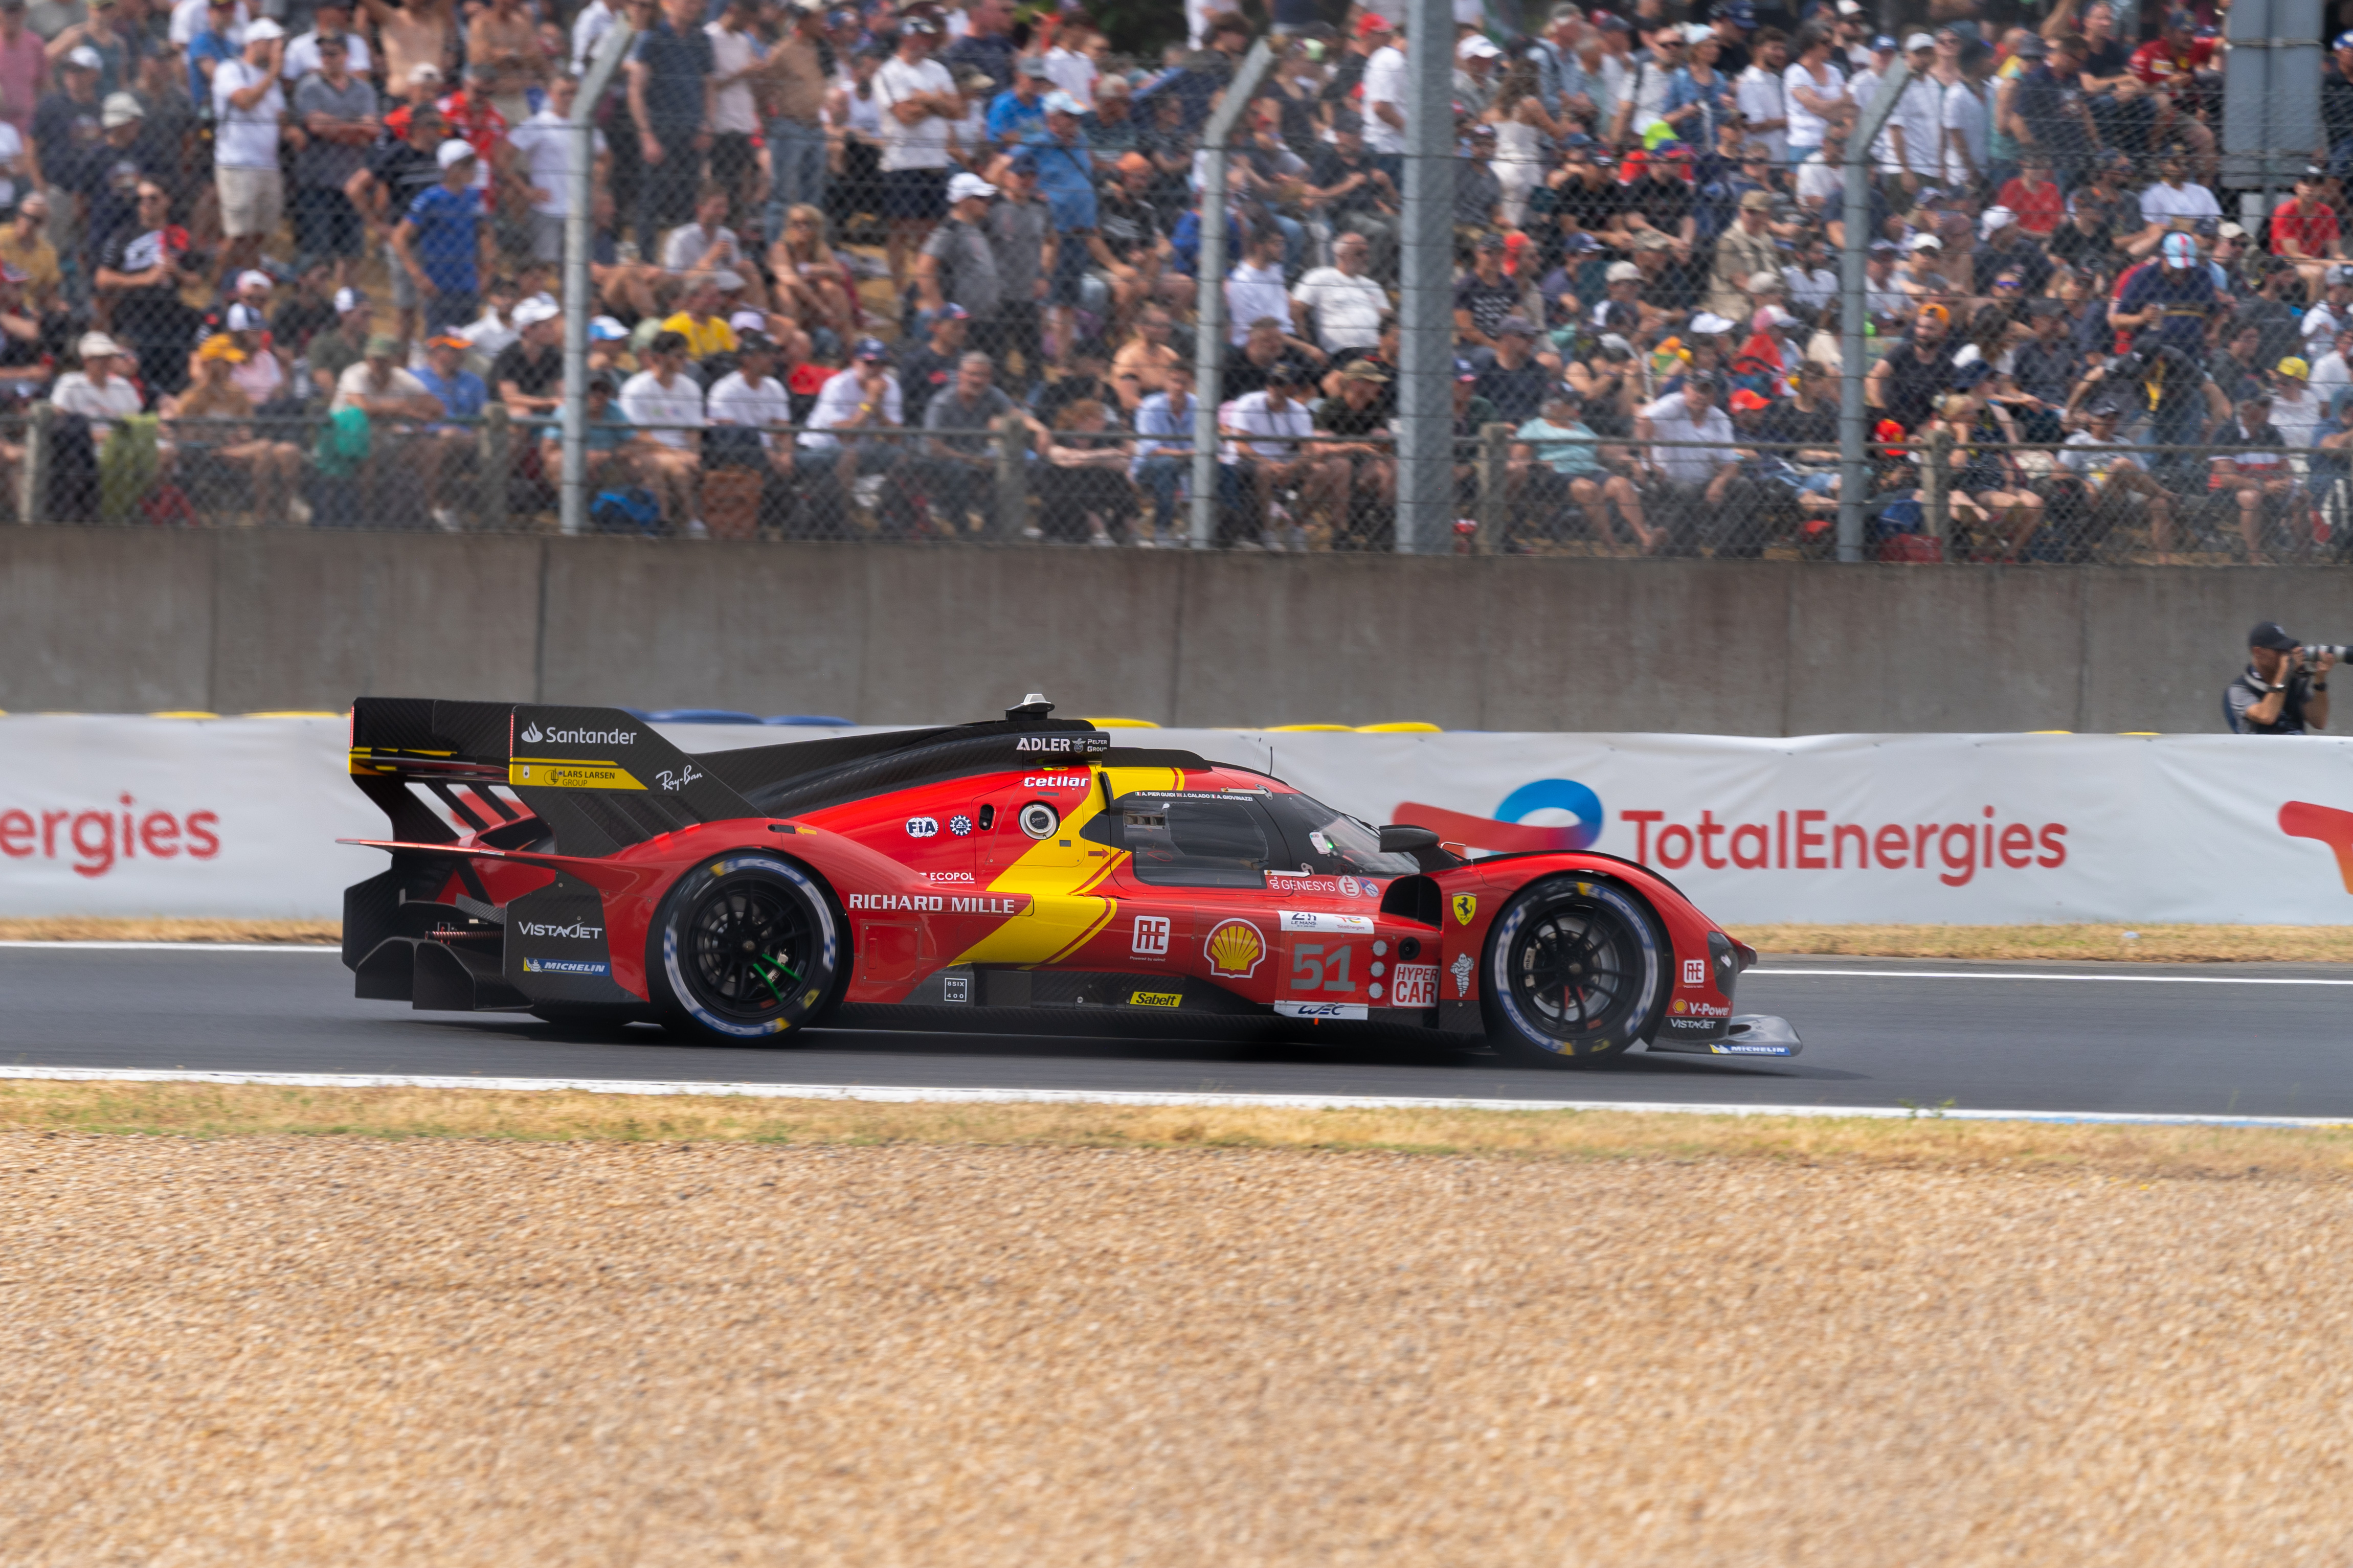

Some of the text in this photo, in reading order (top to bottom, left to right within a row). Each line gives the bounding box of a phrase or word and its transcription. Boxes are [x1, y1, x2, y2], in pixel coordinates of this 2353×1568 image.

[546, 726, 637, 744] Santander
[1016, 737, 1070, 752] ADLER
[563, 770, 582, 778] LARS
[563, 779, 588, 787] GROUP
[1024, 776, 1089, 787] Cetilar
[0, 791, 220, 878] ergies
[1620, 805, 2068, 887] TotalEnergies
[930, 872, 975, 880] ECOPOL
[1281, 879, 1336, 892] GENESYS
[849, 894, 1015, 914] RICHARD MILLE
[544, 962, 605, 972] MICHELIN
[1290, 943, 1356, 992] 51
[1396, 966, 1439, 981] HYPER
[1136, 993, 1177, 1006] Sabelt
[1395, 981, 1436, 1004] CAR
[1297, 1004, 1346, 1016] WEC
[1689, 1002, 1730, 1016] V-Power
